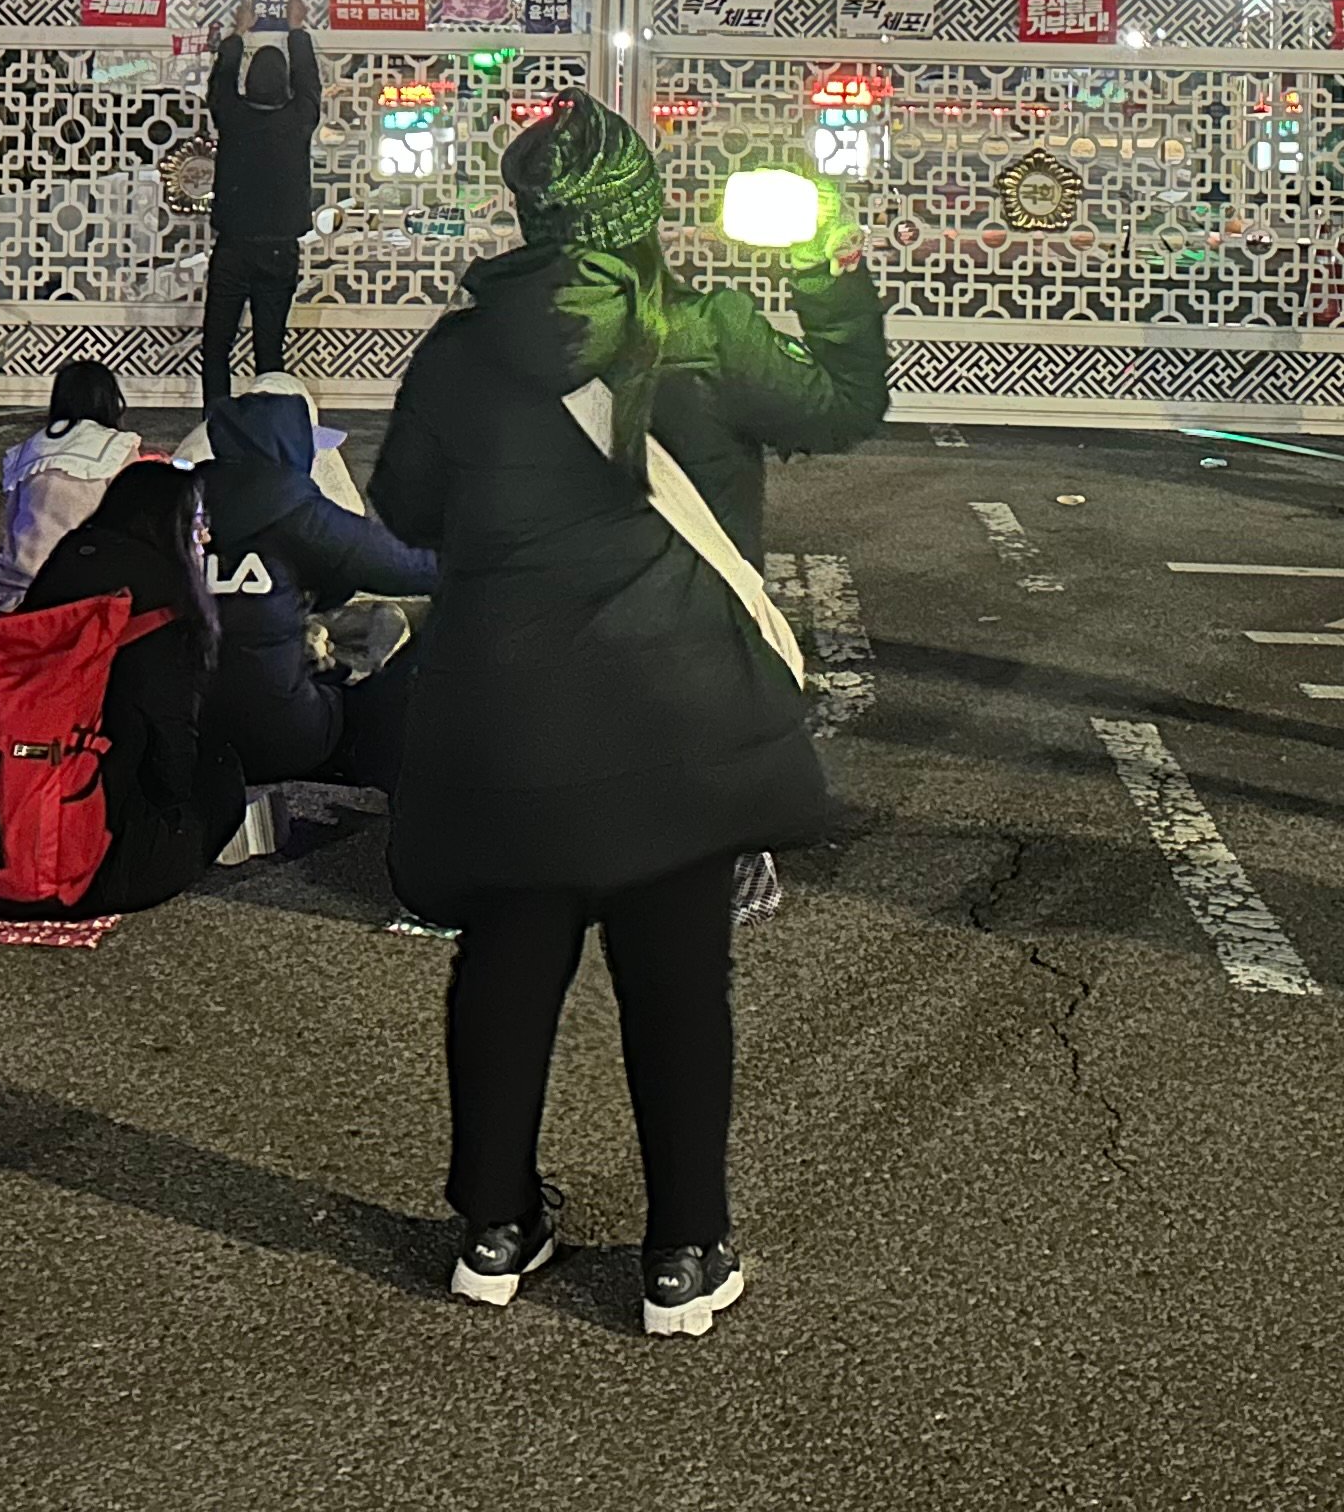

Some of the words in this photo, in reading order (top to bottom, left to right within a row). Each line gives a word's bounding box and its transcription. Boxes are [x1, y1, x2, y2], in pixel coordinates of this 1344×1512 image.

[336, 7, 363, 21] 즉각
[528, 4, 570, 20] 윤석열
[719, 7, 773, 28] 체포!
[840, 0, 887, 19] 즉각
[877, 11, 933, 33] 체포!
[1026, 11, 1110, 36] 거부한다!
[207, 552, 272, 594] LA
